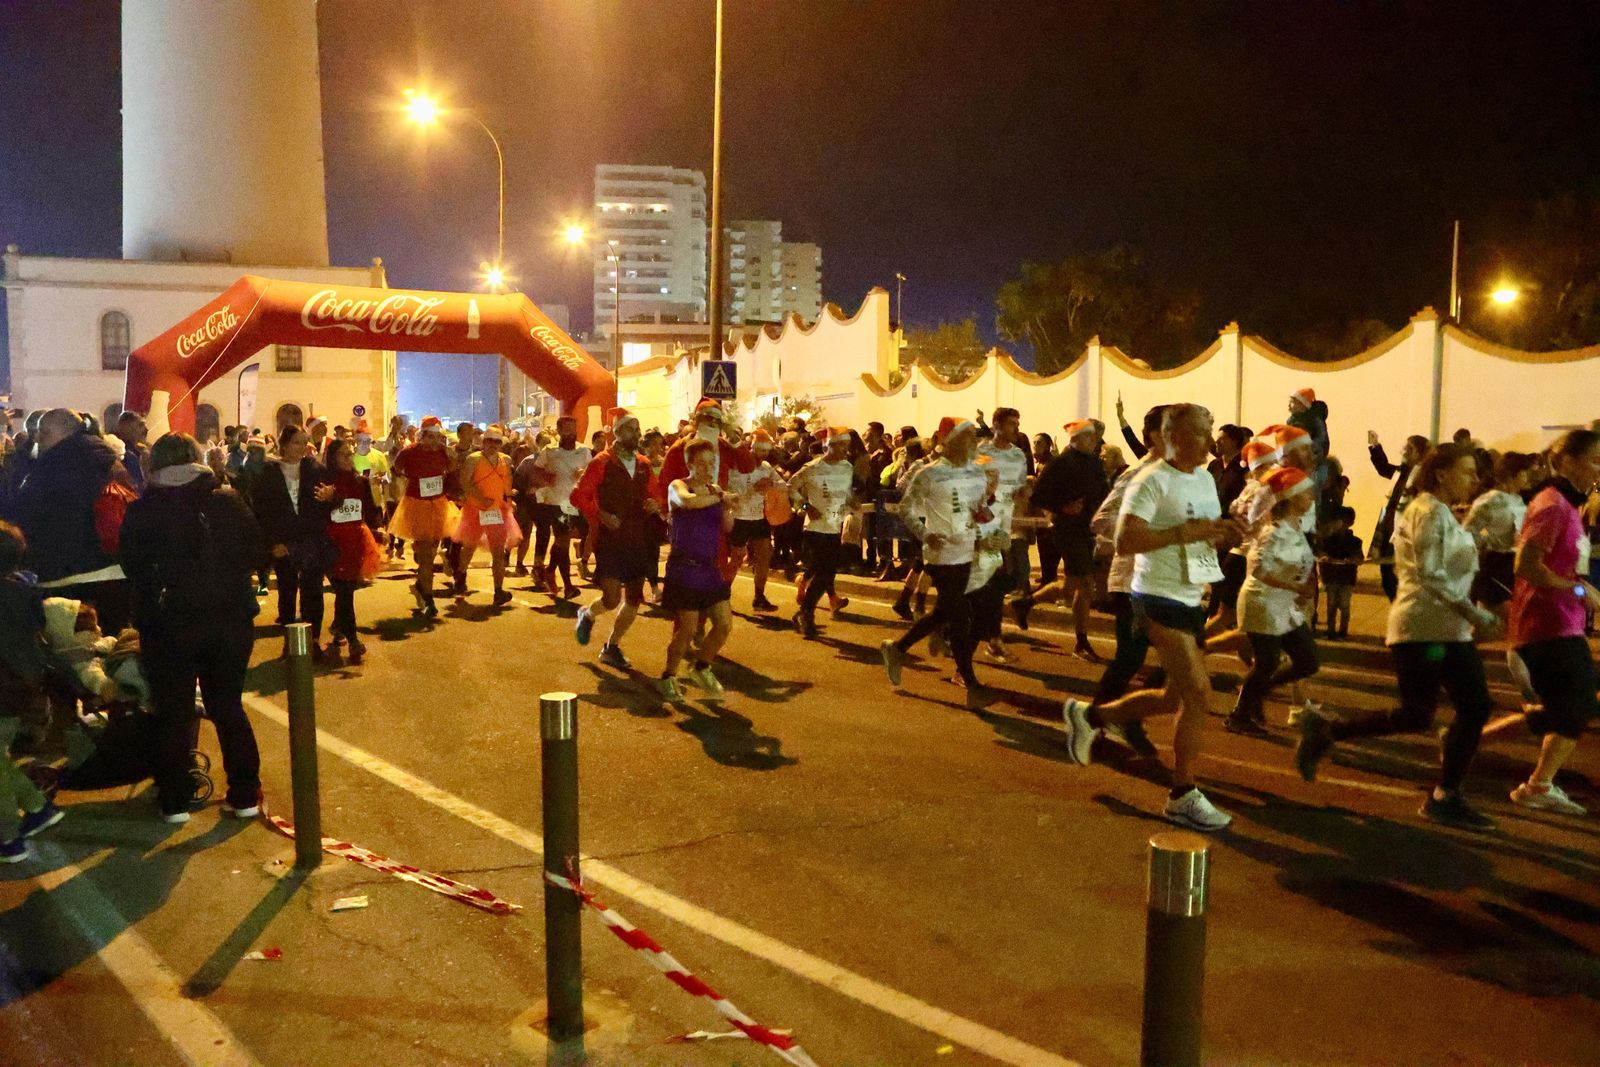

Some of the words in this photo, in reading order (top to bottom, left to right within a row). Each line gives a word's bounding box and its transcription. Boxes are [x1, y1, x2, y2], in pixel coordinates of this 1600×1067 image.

[177, 304, 240, 358] Coca-Cola
[301, 289, 447, 336] Coca-Cola
[531, 325, 587, 372] Coca-Cola
